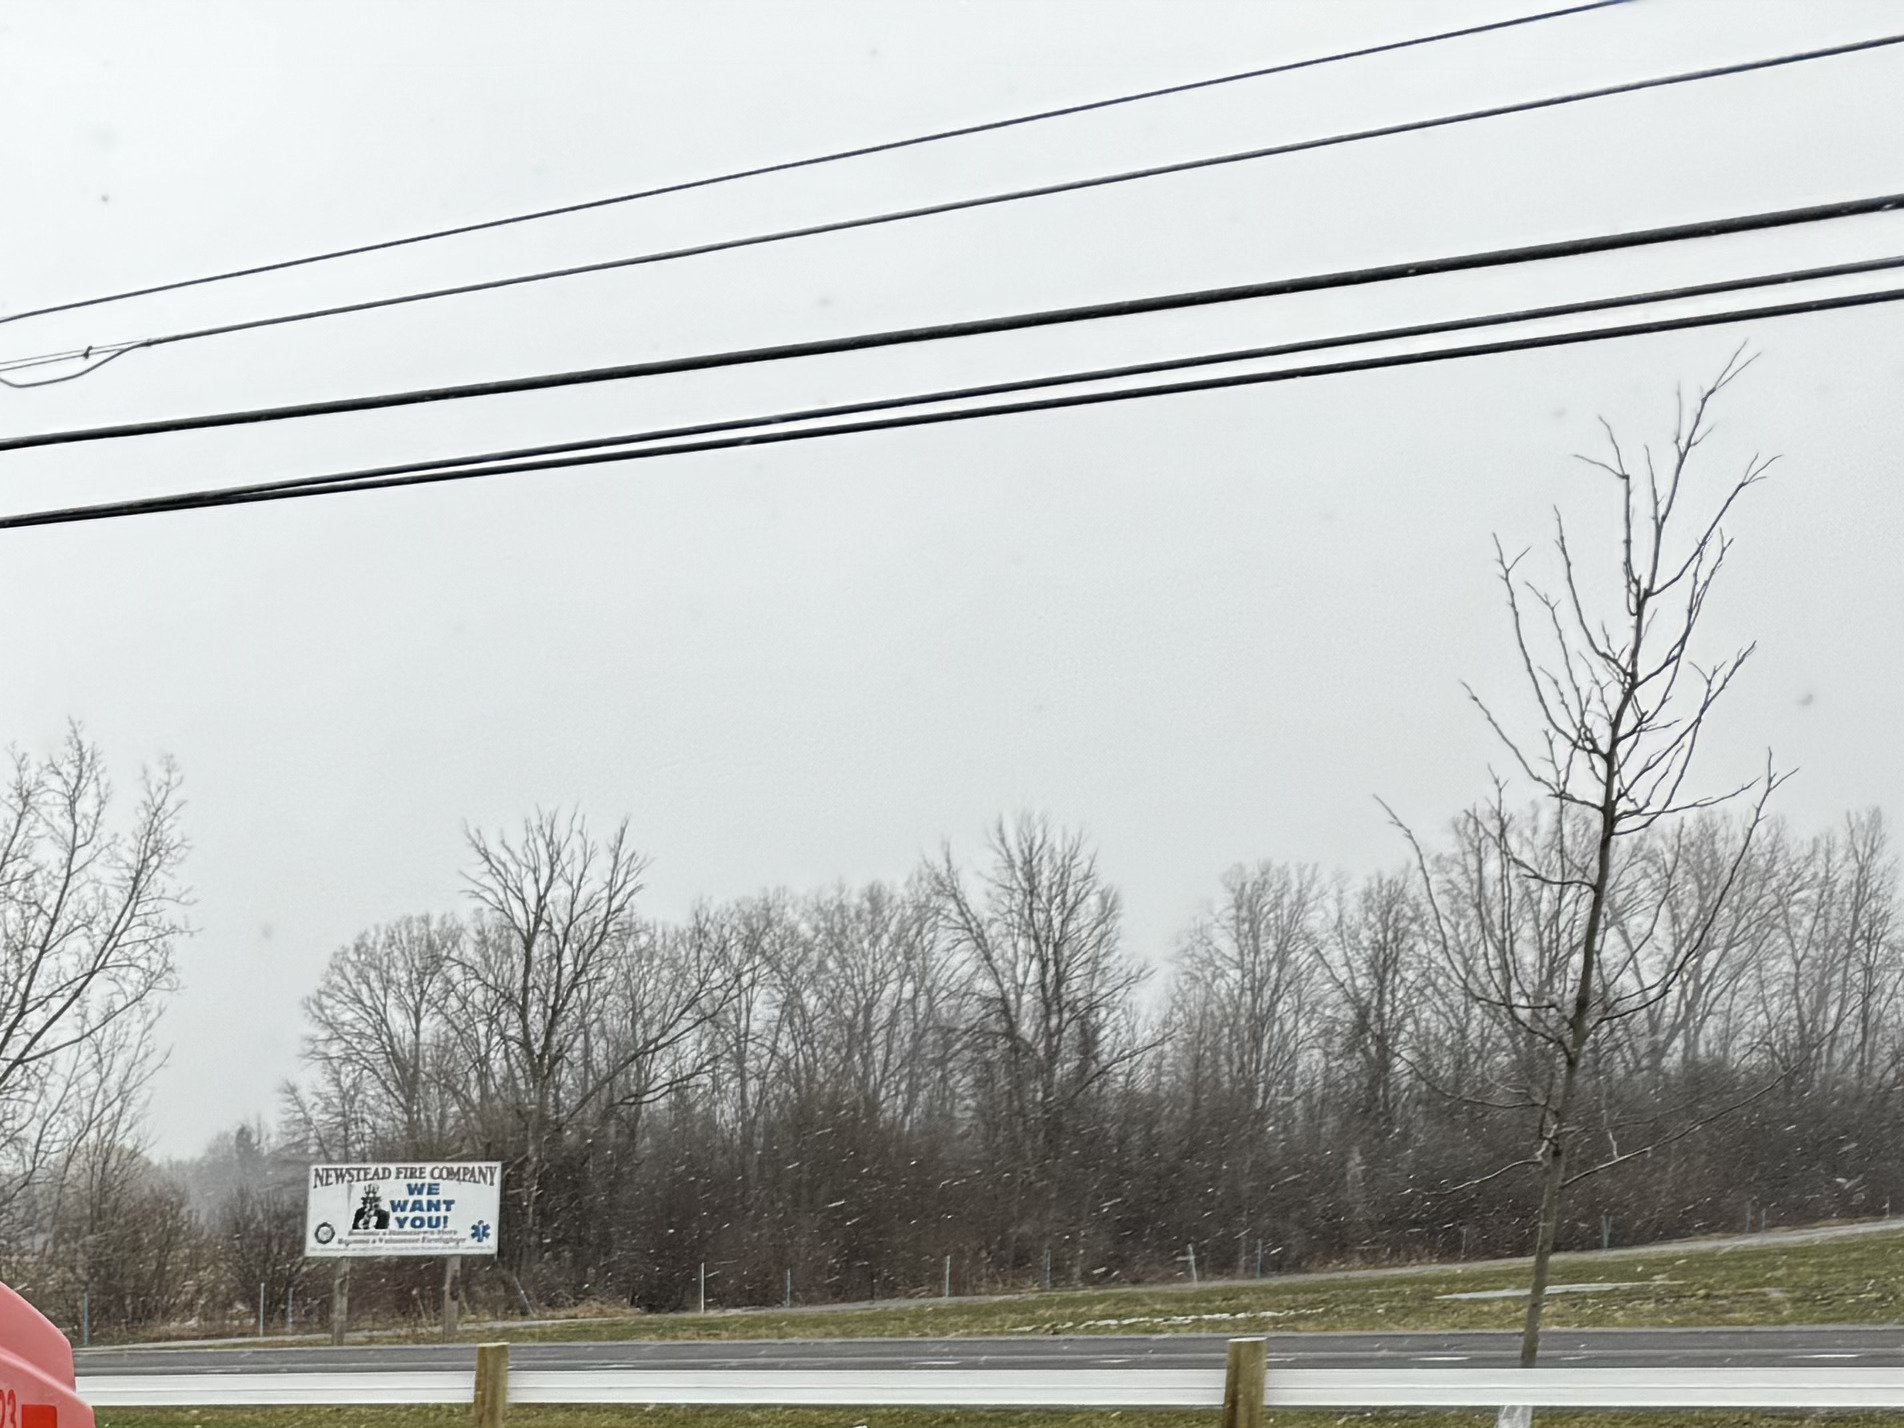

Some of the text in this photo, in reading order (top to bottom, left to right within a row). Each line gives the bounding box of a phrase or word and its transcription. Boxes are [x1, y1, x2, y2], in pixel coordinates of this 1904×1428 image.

[313, 1165, 498, 1189] NEWSTEAD FIRE COMPANY
[406, 1183, 440, 1195] WE
[390, 1199, 455, 1212] WANT
[395, 1215, 448, 1229] YOU!
